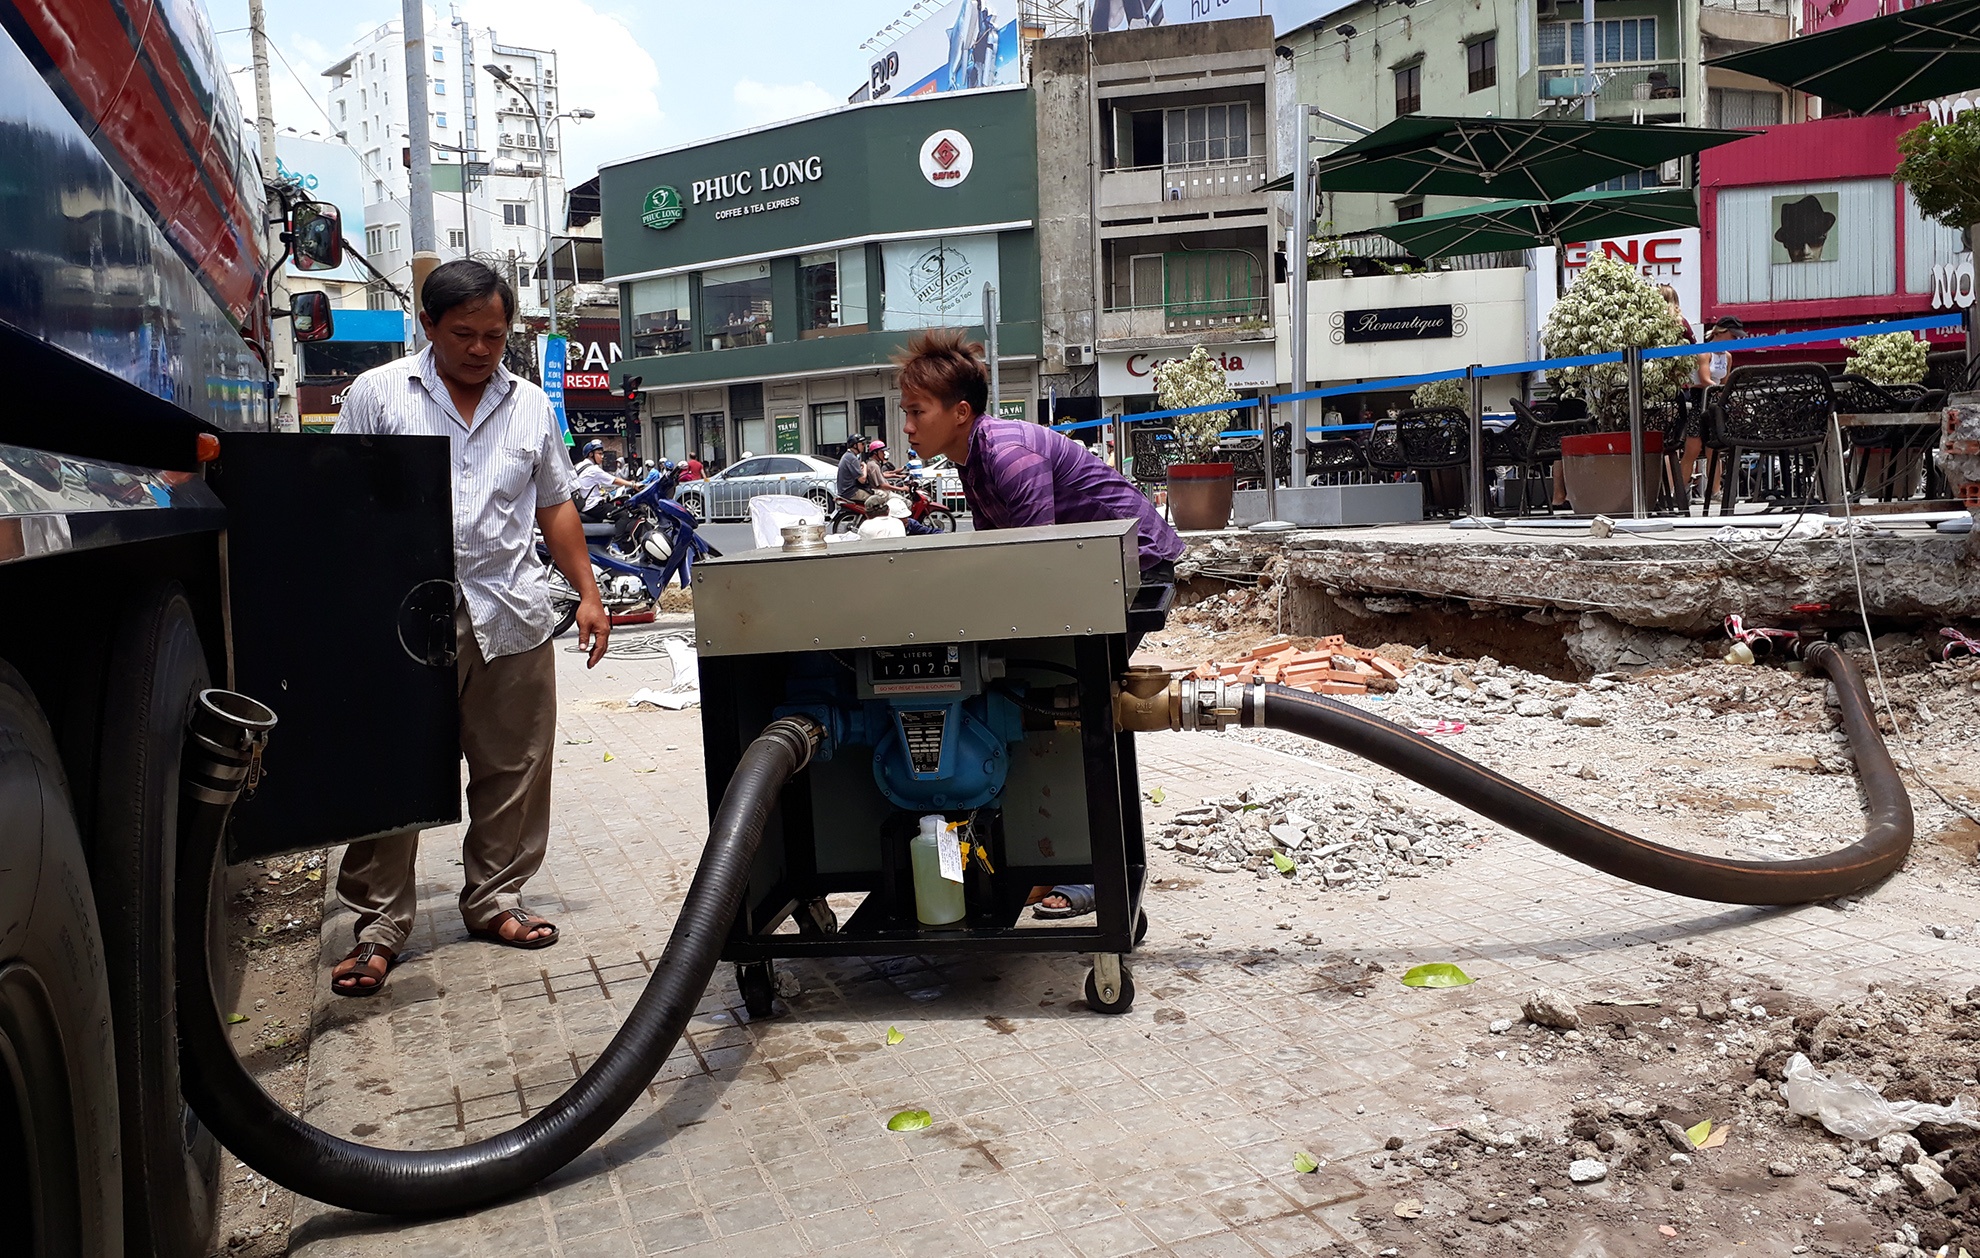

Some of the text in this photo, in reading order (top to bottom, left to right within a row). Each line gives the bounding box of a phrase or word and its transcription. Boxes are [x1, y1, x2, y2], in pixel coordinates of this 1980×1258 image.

[692, 156, 823, 204] PHUC LONG
[933, 171, 961, 180] SAVICO
[642, 212, 661, 223] PHUC
[715, 196, 800, 220] COFFEE & TEA EXPRESS
[1634, 265, 1682, 276] ELL
[917, 279, 942, 302] PHUC
[945, 266, 973, 286] LONG
[1352, 313, 1445, 335] Romantique
